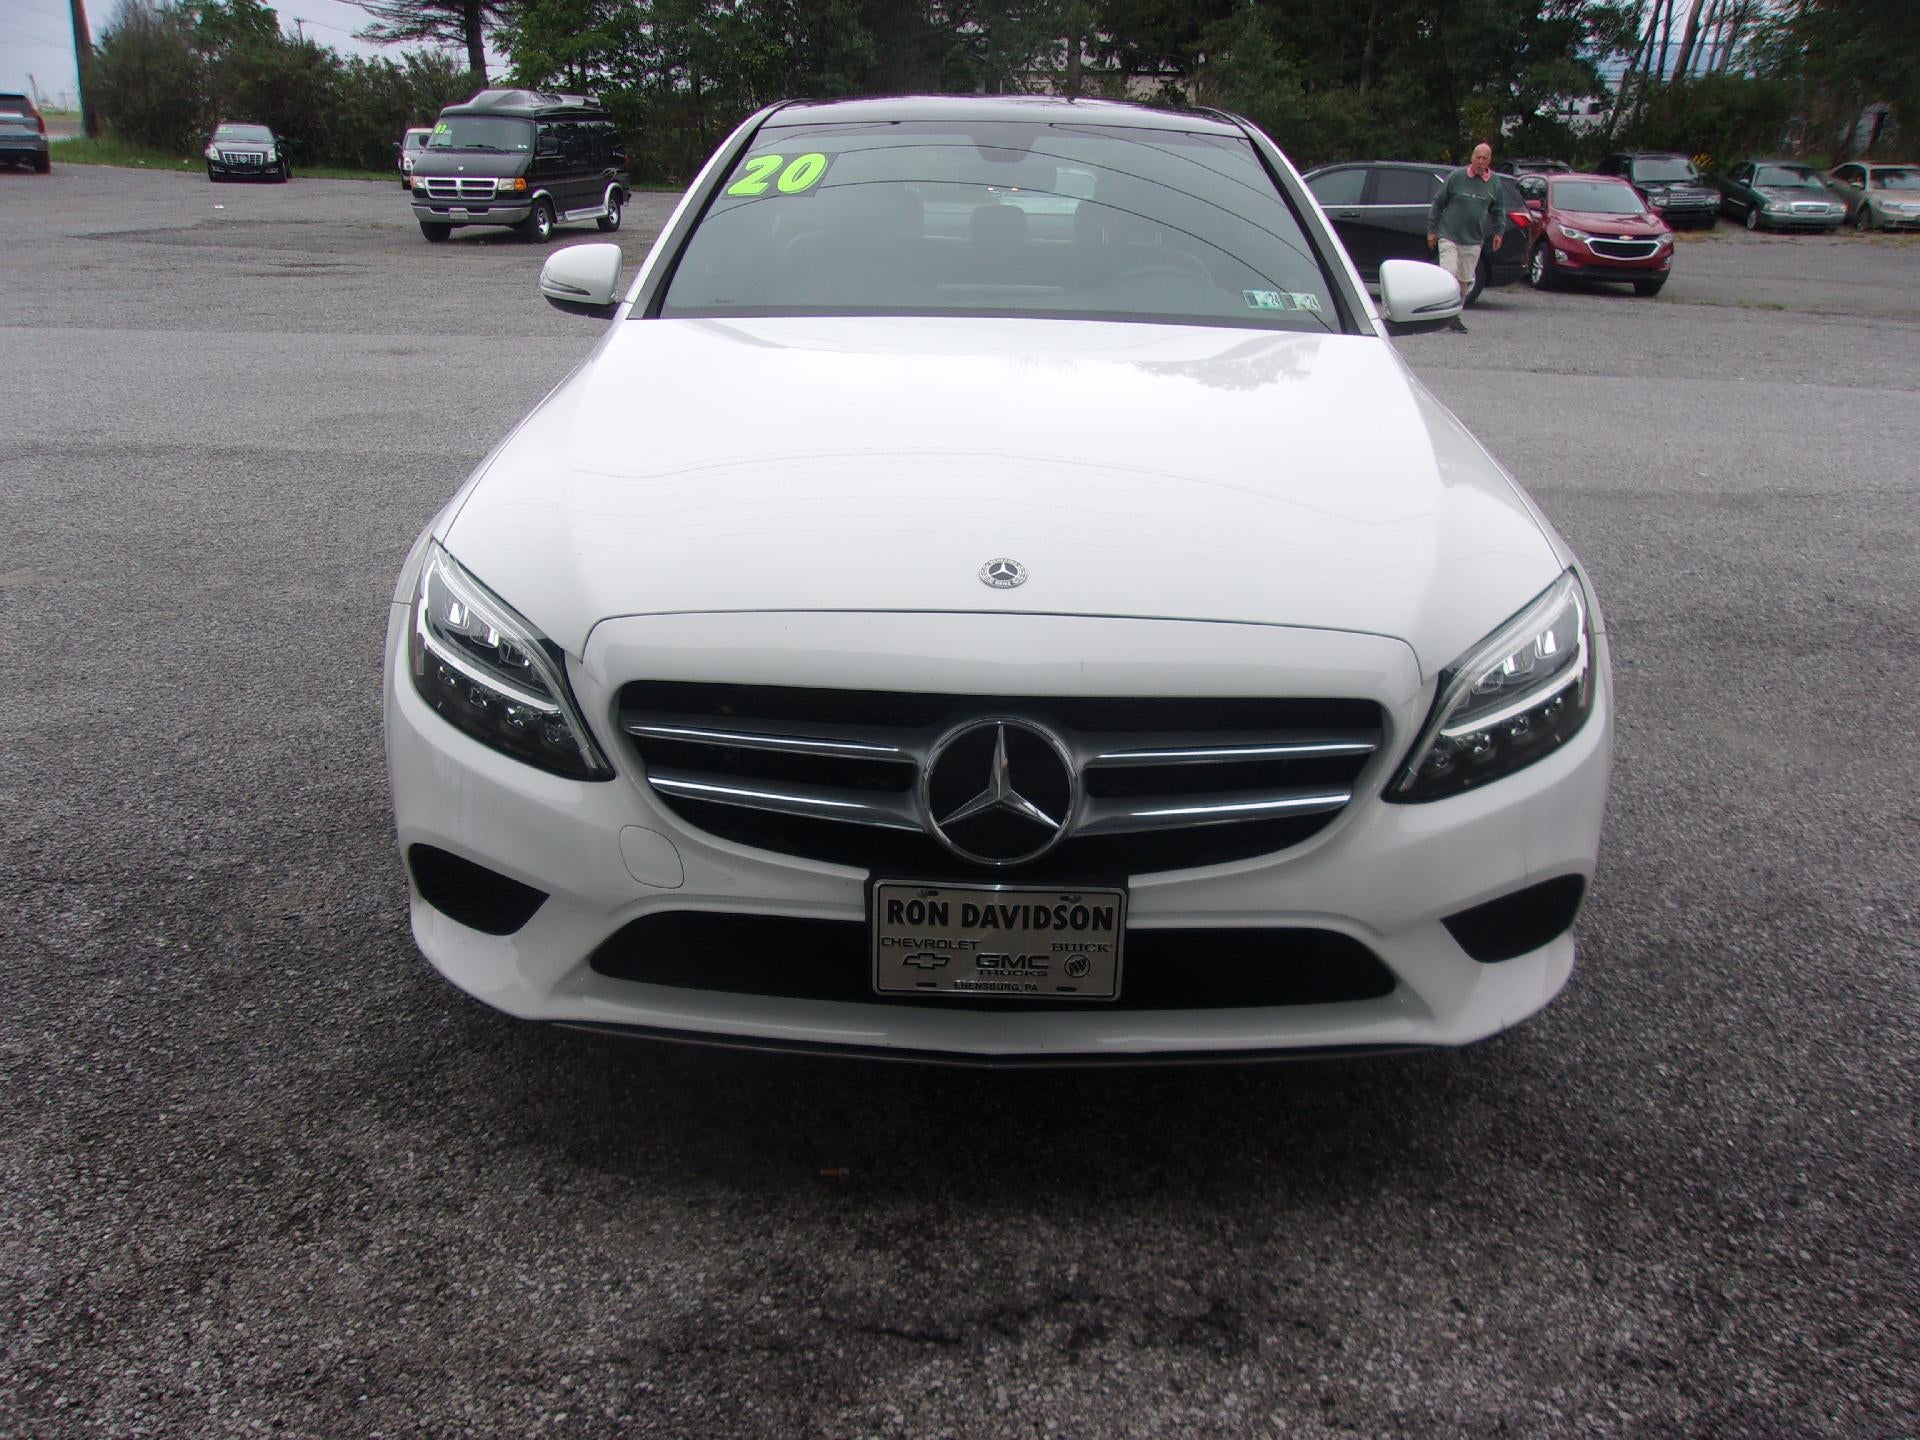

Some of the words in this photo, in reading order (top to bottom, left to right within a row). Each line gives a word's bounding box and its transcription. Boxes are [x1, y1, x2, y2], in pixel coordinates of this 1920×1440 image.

[727, 153, 828, 196] 20
[887, 899, 949, 927] RON
[961, 903, 1113, 931] DAVIDSON
[881, 937, 981, 951] CHEVROLET
[1049, 943, 1110, 953] BUICK
[975, 953, 1050, 970] GMC
[978, 969, 1049, 978] TRUCKS
[1024, 982, 1038, 992] PA
